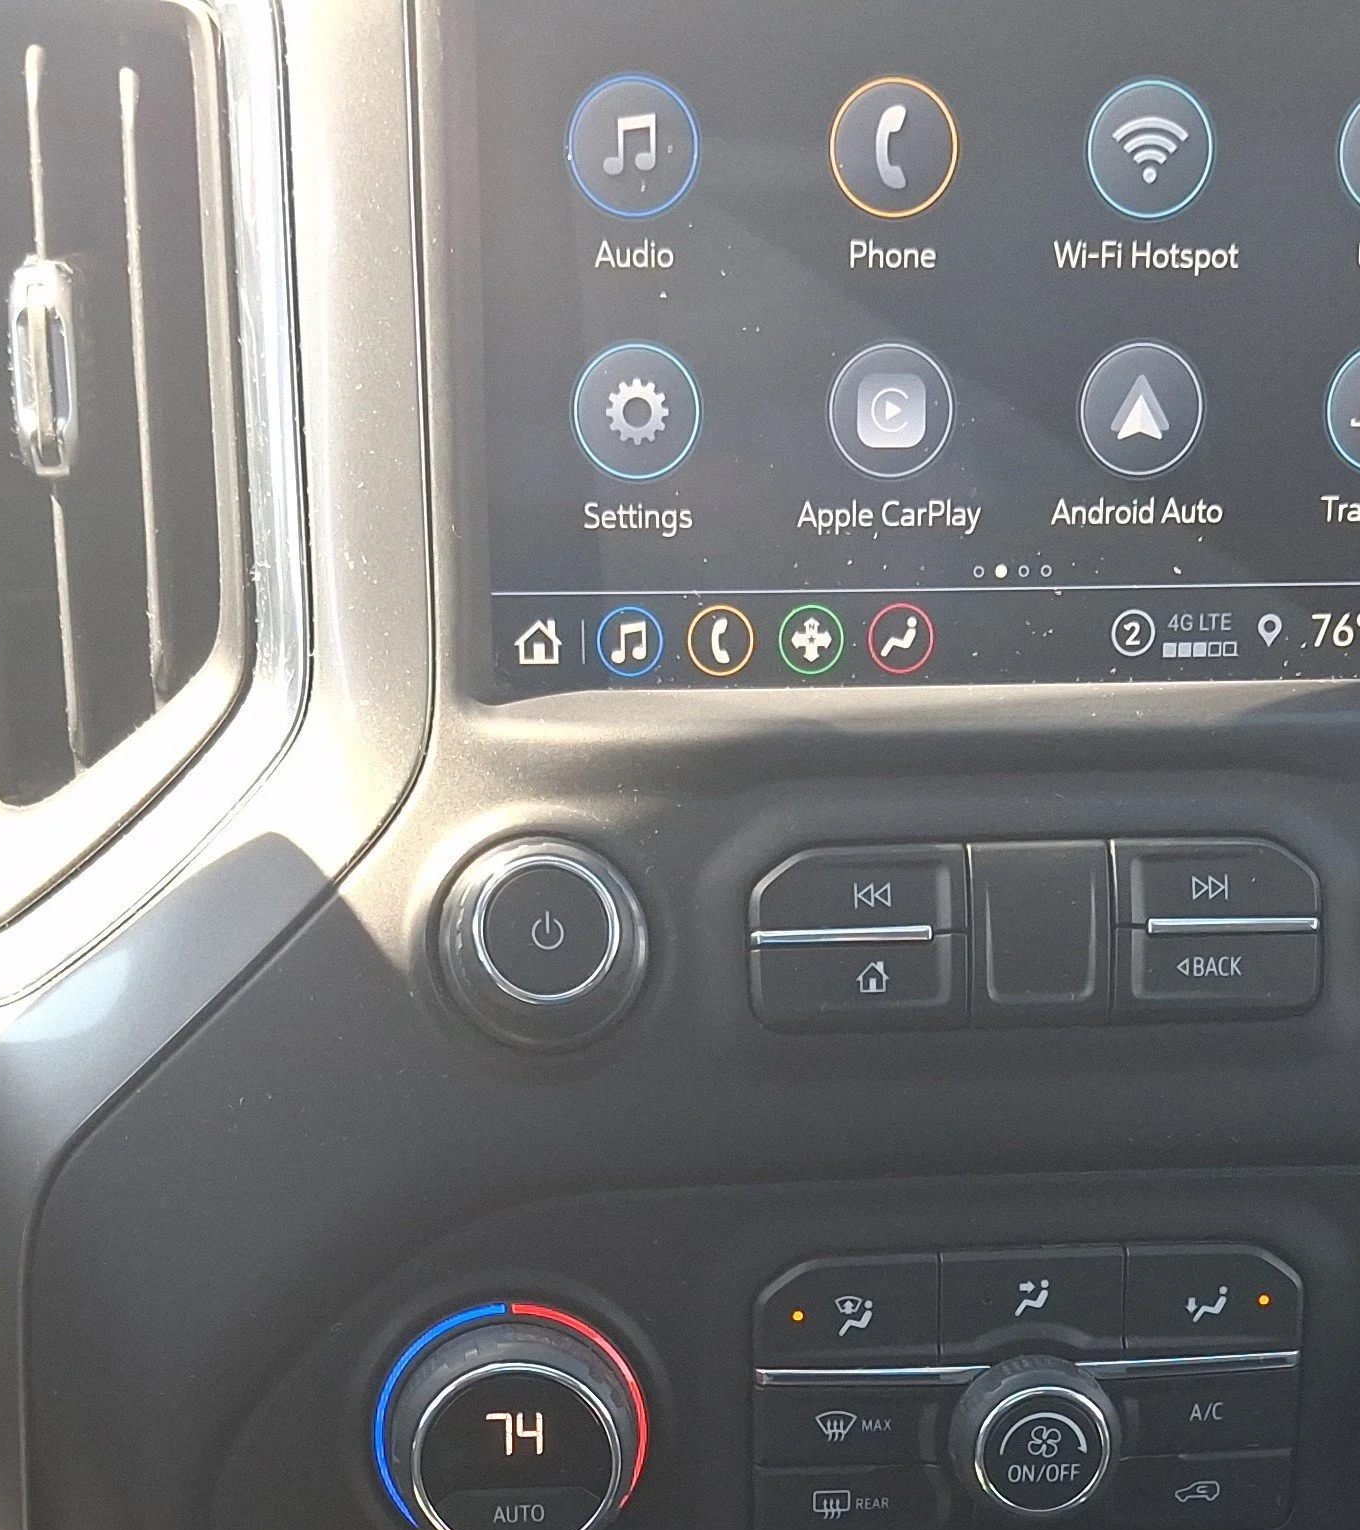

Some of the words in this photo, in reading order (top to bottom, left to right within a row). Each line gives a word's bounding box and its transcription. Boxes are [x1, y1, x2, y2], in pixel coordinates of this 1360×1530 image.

[595, 239, 674, 270] Audio
[848, 239, 937, 270] Phone
[1053, 240, 1124, 270] Wi-Fi
[1131, 240, 1239, 275] Hotspot
[583, 503, 693, 537] Settings
[797, 500, 875, 534] Apple
[881, 499, 982, 534] CarPlay
[1051, 498, 1155, 526] Android
[1160, 498, 1223, 526] Auto
[1123, 621, 1143, 647] 2
[1167, 613, 1194, 632] 4G
[1199, 612, 1232, 632] LTE
[1193, 956, 1242, 977] BACK
[1190, 1402, 1224, 1421] A/C
[485, 1411, 545, 1456] 74
[861, 1418, 892, 1432] MAX
[1007, 1464, 1080, 1484] ON/OFF
[493, 1504, 545, 1525] AUTO
[855, 1497, 890, 1511] REAR
